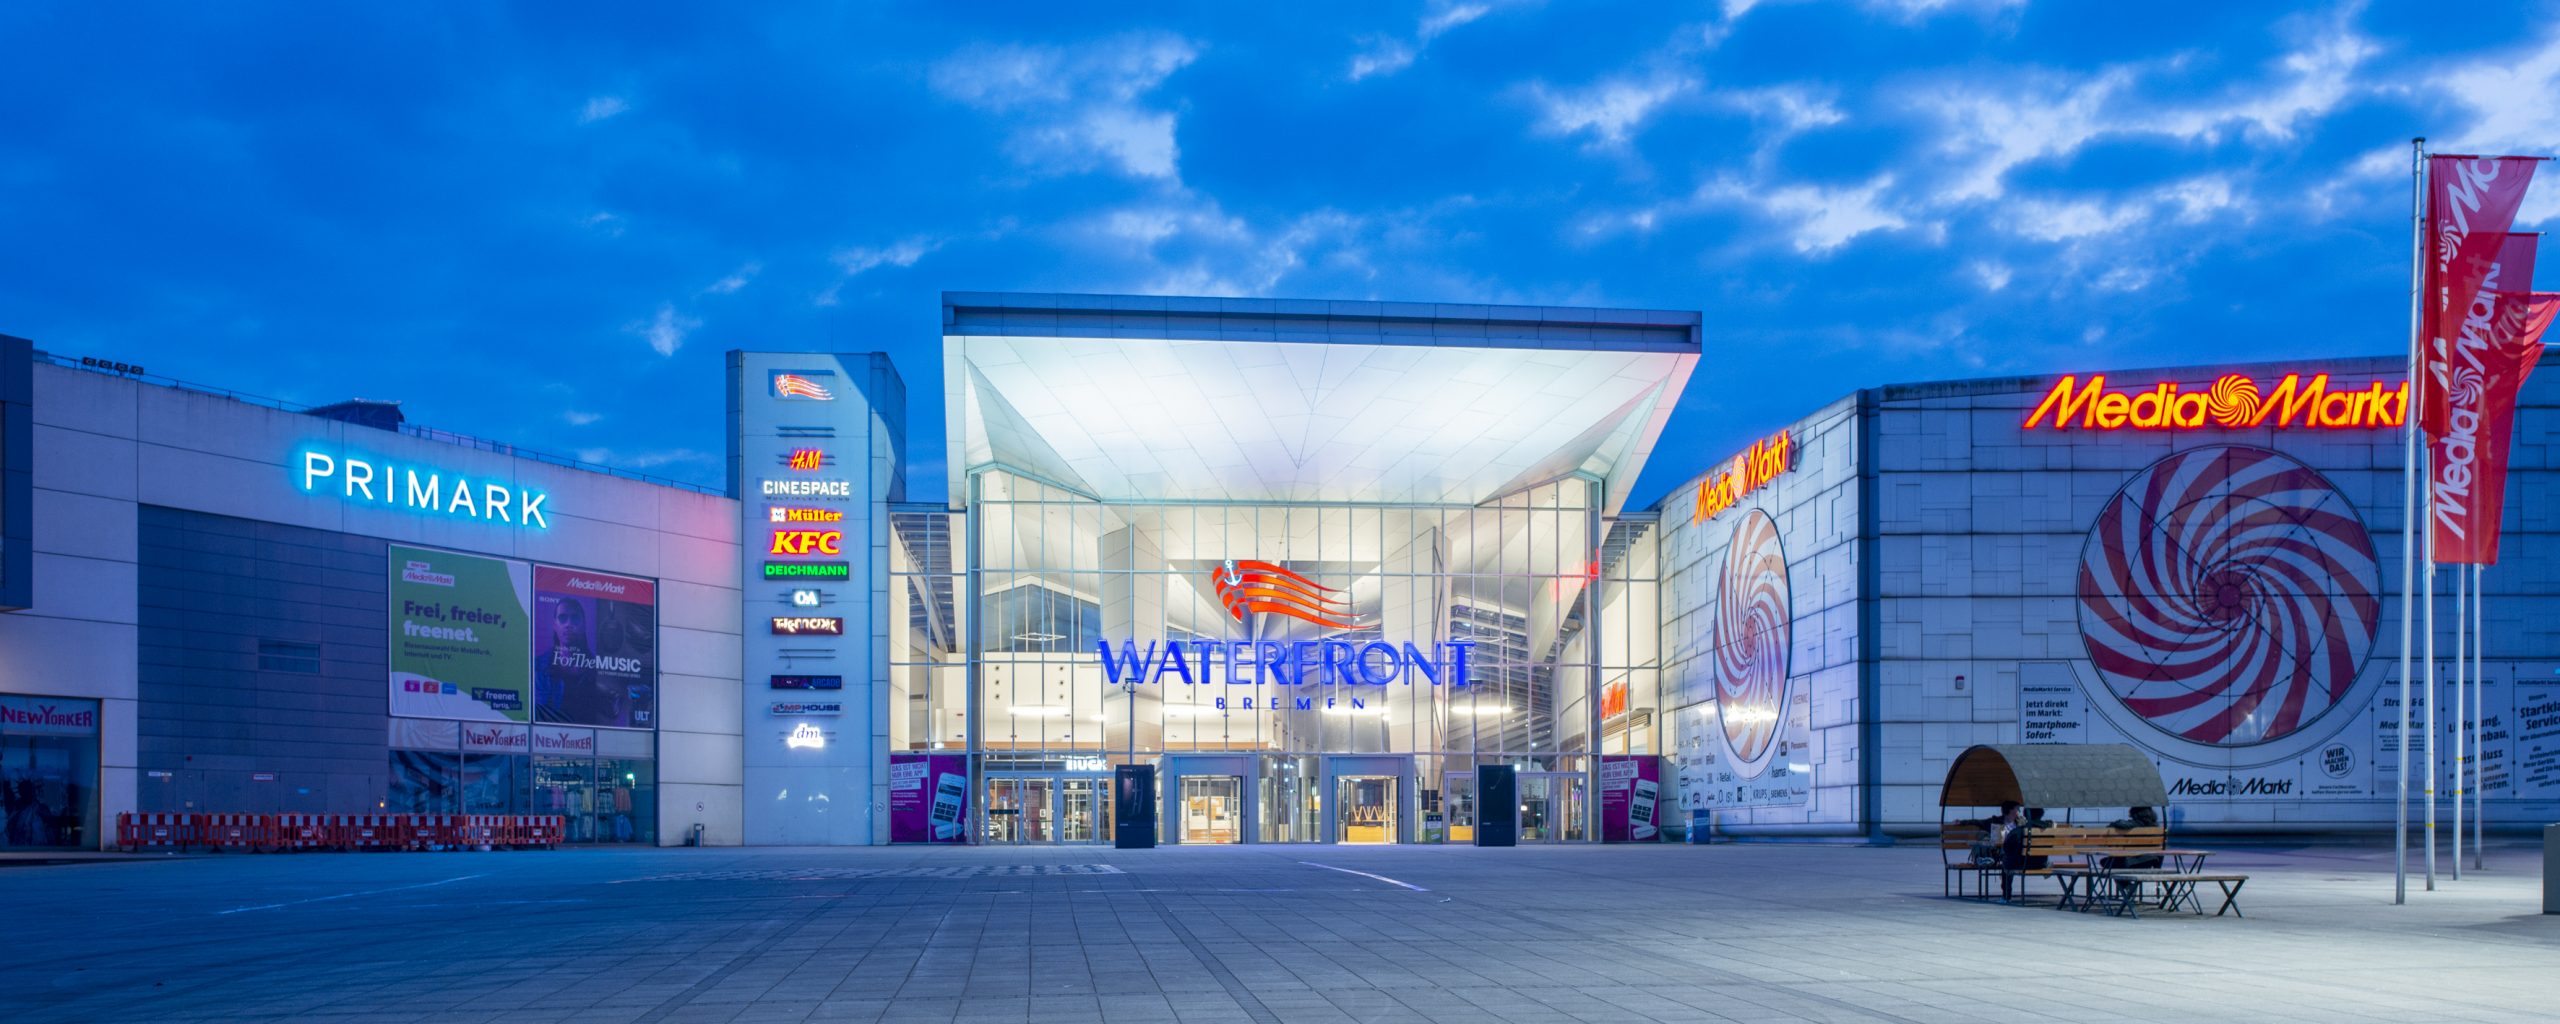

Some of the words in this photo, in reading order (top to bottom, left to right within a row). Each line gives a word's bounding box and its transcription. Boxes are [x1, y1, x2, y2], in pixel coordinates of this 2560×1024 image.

[2023, 376, 2209, 428] Media
[2250, 374, 2409, 427] Markt
[790, 450, 822, 471] H&M
[1693, 471, 1734, 528] Media
[1742, 429, 1788, 496] Markt
[2435, 408, 2480, 541] Media
[304, 451, 548, 530] PRIMARK
[763, 480, 850, 496] CINESPACE
[787, 508, 843, 521] Müller
[770, 531, 842, 554] KFC
[765, 564, 848, 576] DEICHMANN
[404, 600, 446, 622] Frei,
[450, 605, 507, 628] freier,
[403, 620, 479, 642] freenet.
[1097, 638, 1477, 686] WATERFRONT
[485, 690, 516, 701] freenet
[802, 704, 841, 712] HOUSE
[1215, 696, 1365, 711] BREMEN
[2045, 700, 2069, 708] direkt
[634, 710, 650, 721] ULT
[2026, 709, 2036, 717] im
[2038, 709, 2063, 717] Markt:
[2026, 720, 2081, 731] Smartphone-
[2526, 714, 2560, 731] Servic
[796, 727, 818, 739] dm
[2026, 730, 2056, 740] Sofort-
[2326, 747, 2345, 758] WIR
[2324, 755, 2350, 766] MACHEN
[1771, 766, 1787, 778] hama
[2329, 762, 2348, 773] DAS!
[2168, 778, 2226, 795] Media
[2241, 777, 2293, 795] Markt
[1753, 789, 1768, 799] KRUPS
[1770, 788, 1788, 799] SIEMENS
